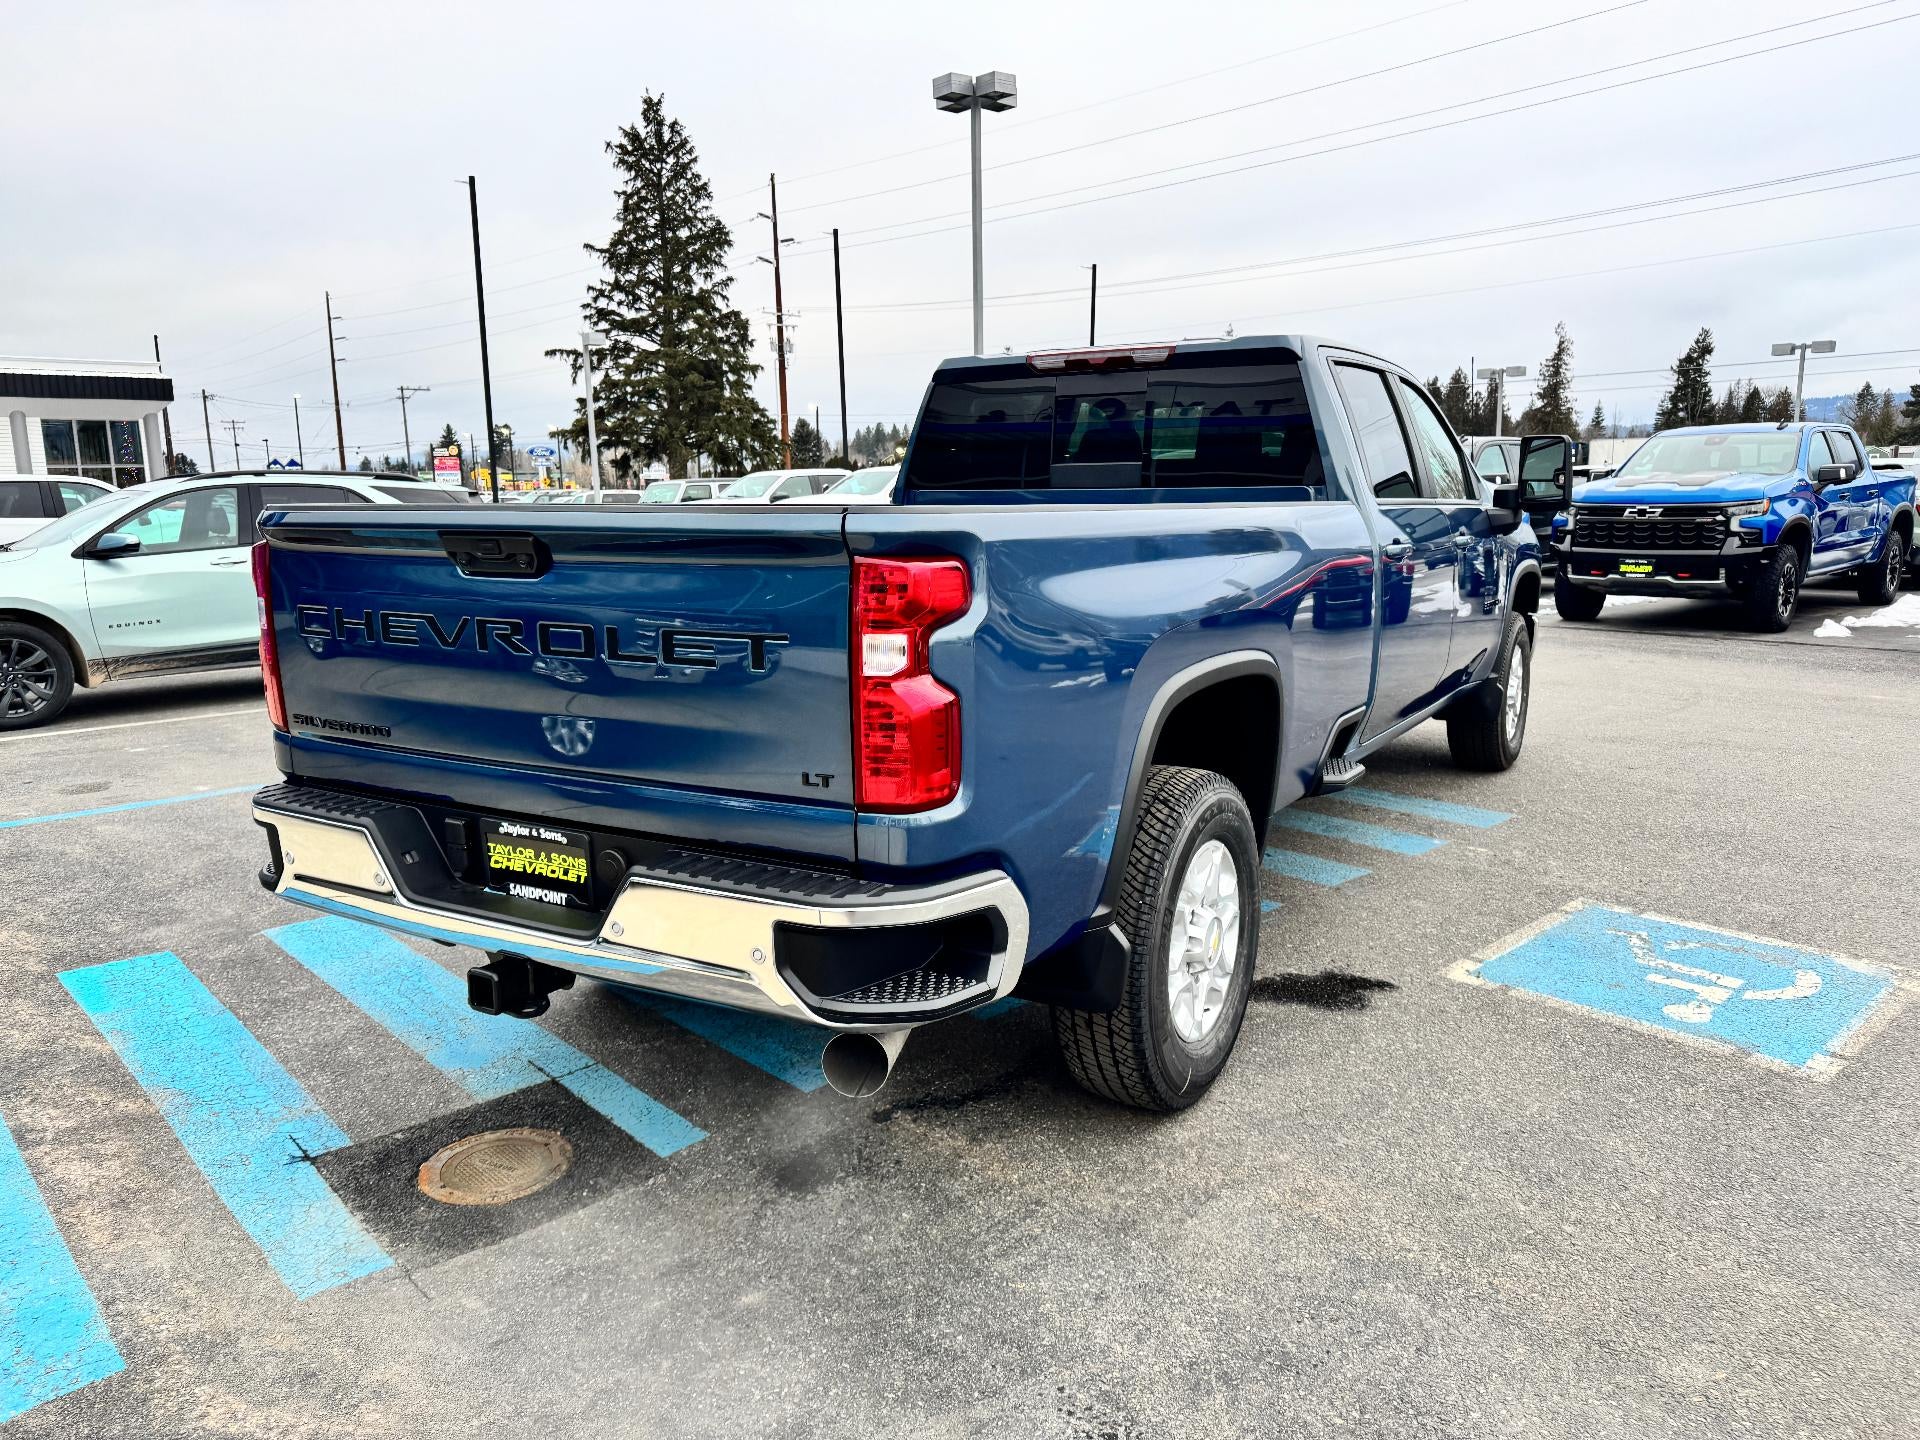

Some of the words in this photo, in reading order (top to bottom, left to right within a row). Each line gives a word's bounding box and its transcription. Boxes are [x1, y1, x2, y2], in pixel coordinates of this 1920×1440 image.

[108, 619, 161, 629] EQUINOX
[296, 604, 790, 673] CHEVROLET
[292, 712, 393, 738] SILVERADO
[801, 771, 835, 788] LT
[501, 822, 530, 837] Taylor
[532, 828, 538, 836] &
[539, 828, 562, 841] Sons
[487, 843, 535, 859] TAYLOR
[539, 851, 548, 863] &
[550, 853, 587, 870] SONS
[489, 855, 588, 884] CHEVROLET
[509, 882, 568, 906] SANDPOINT
